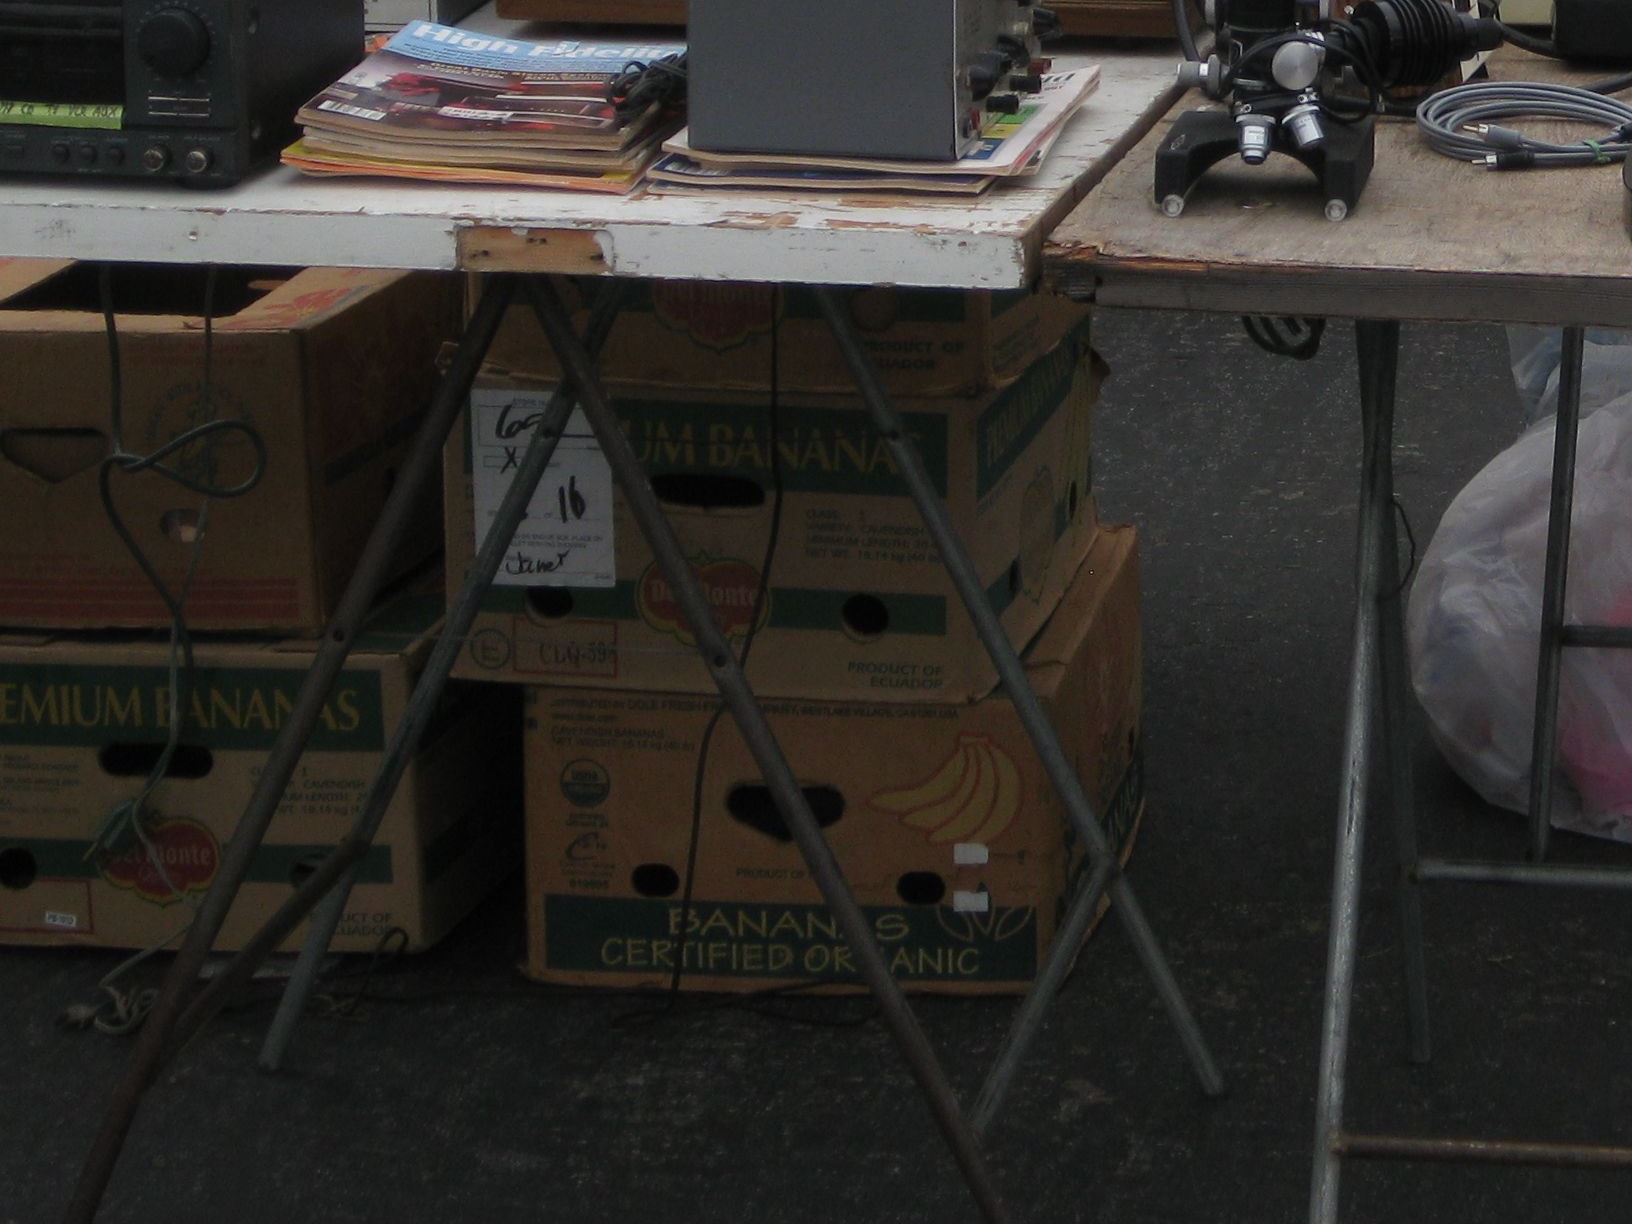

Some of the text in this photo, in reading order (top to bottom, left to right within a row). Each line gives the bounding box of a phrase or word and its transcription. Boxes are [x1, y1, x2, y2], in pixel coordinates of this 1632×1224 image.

[413, 24, 519, 55] High
[560, 475, 586, 523] 16
[847, 662, 943, 677] PRODUCT OF
[869, 677, 943, 690] ECUADOR
[373, 913, 392, 923] OF
[601, 936, 979, 976] CERTIFIED ORANIC
